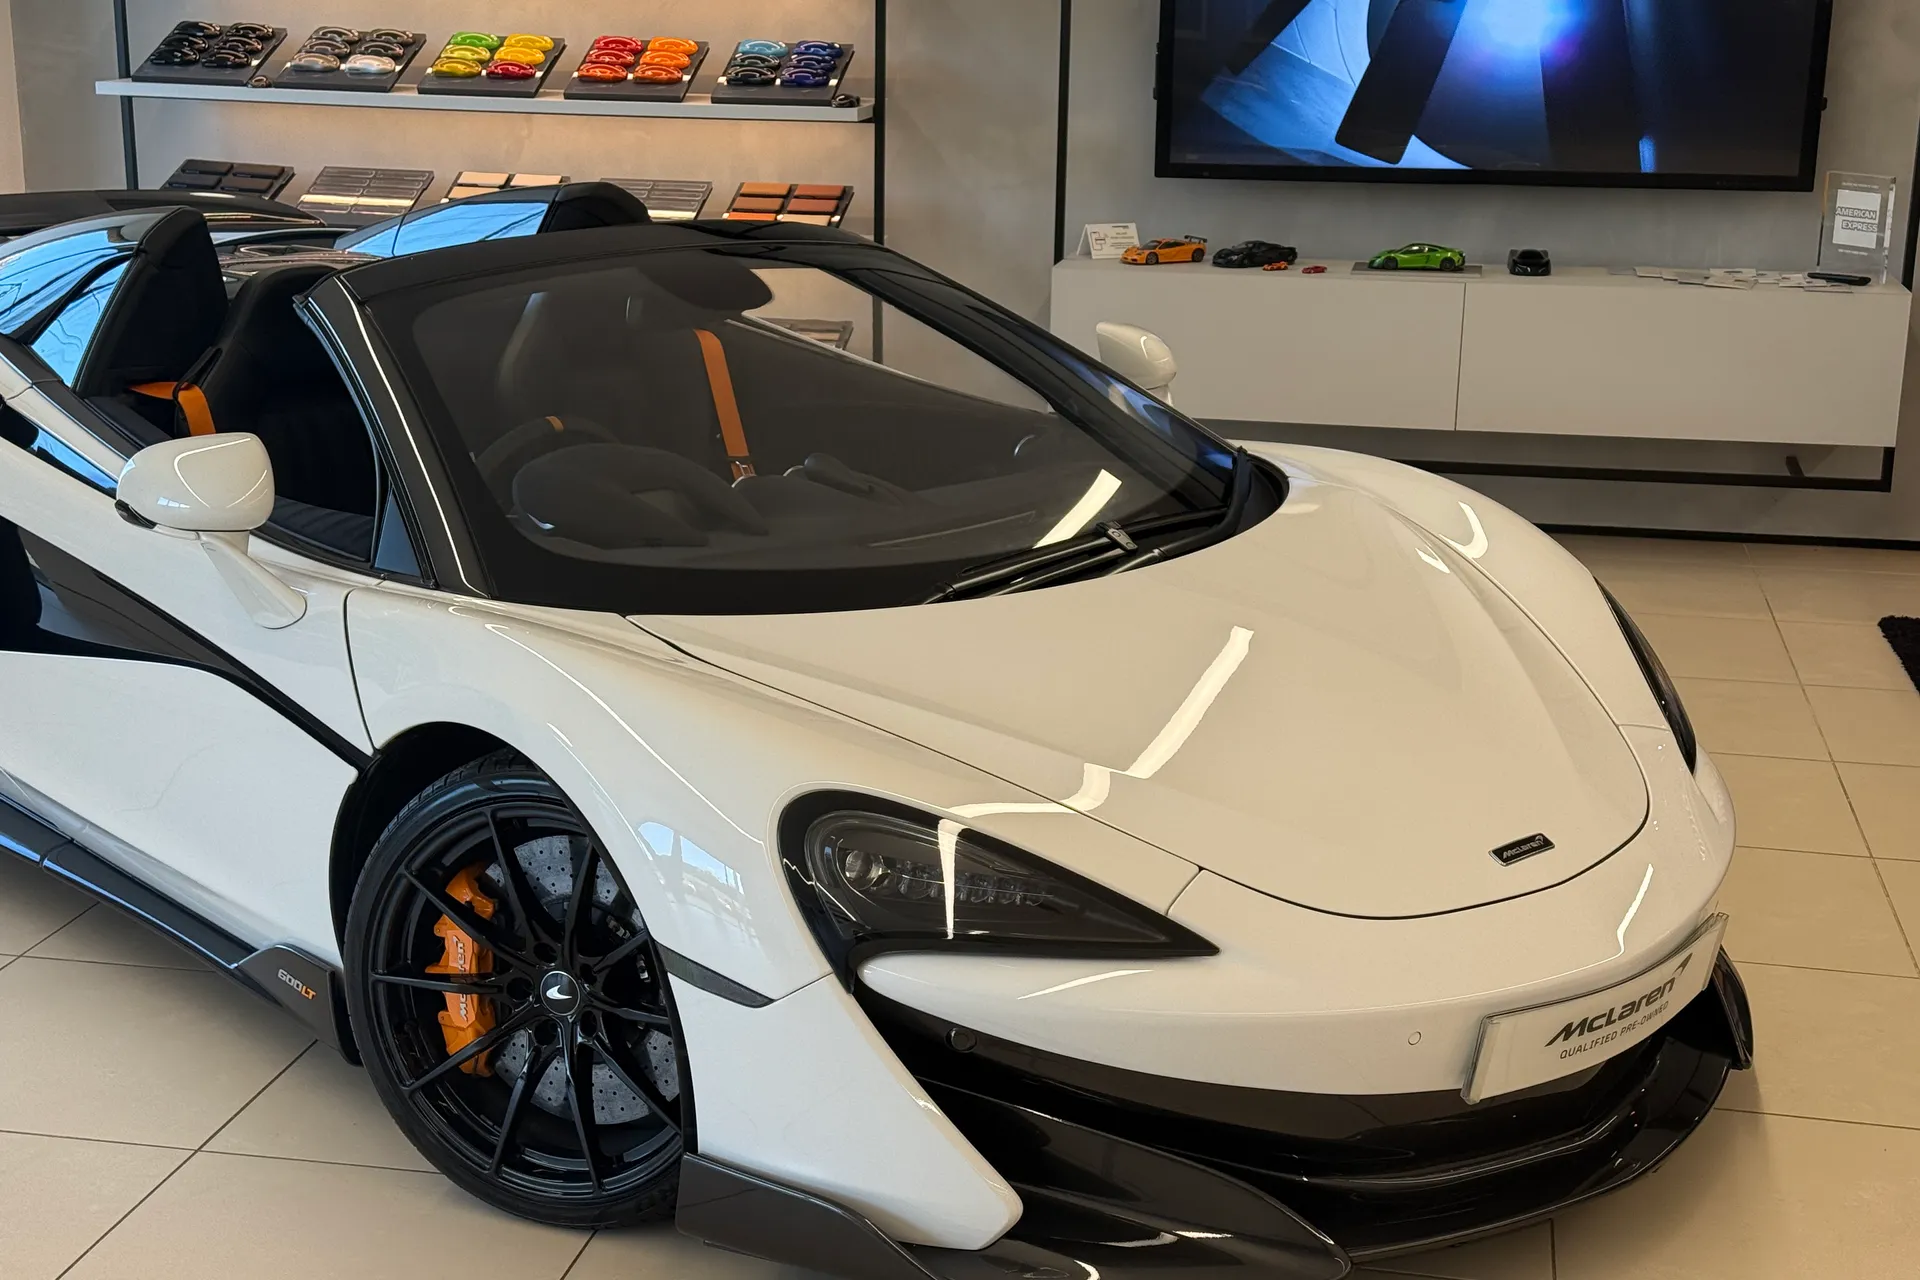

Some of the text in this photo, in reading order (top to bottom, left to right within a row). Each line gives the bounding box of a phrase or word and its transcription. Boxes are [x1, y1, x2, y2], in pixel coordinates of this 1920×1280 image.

[1835, 206, 1877, 219] AMERICAN
[1841, 220, 1878, 232] EXPRESS
[1503, 840, 1544, 859] McLaren
[277, 968, 317, 1000] 600LT
[457, 942, 468, 1022] Mcren
[1544, 977, 1676, 1047] McLaren
[1560, 1000, 1669, 1060] QUALIFIED PRE-OWNED
